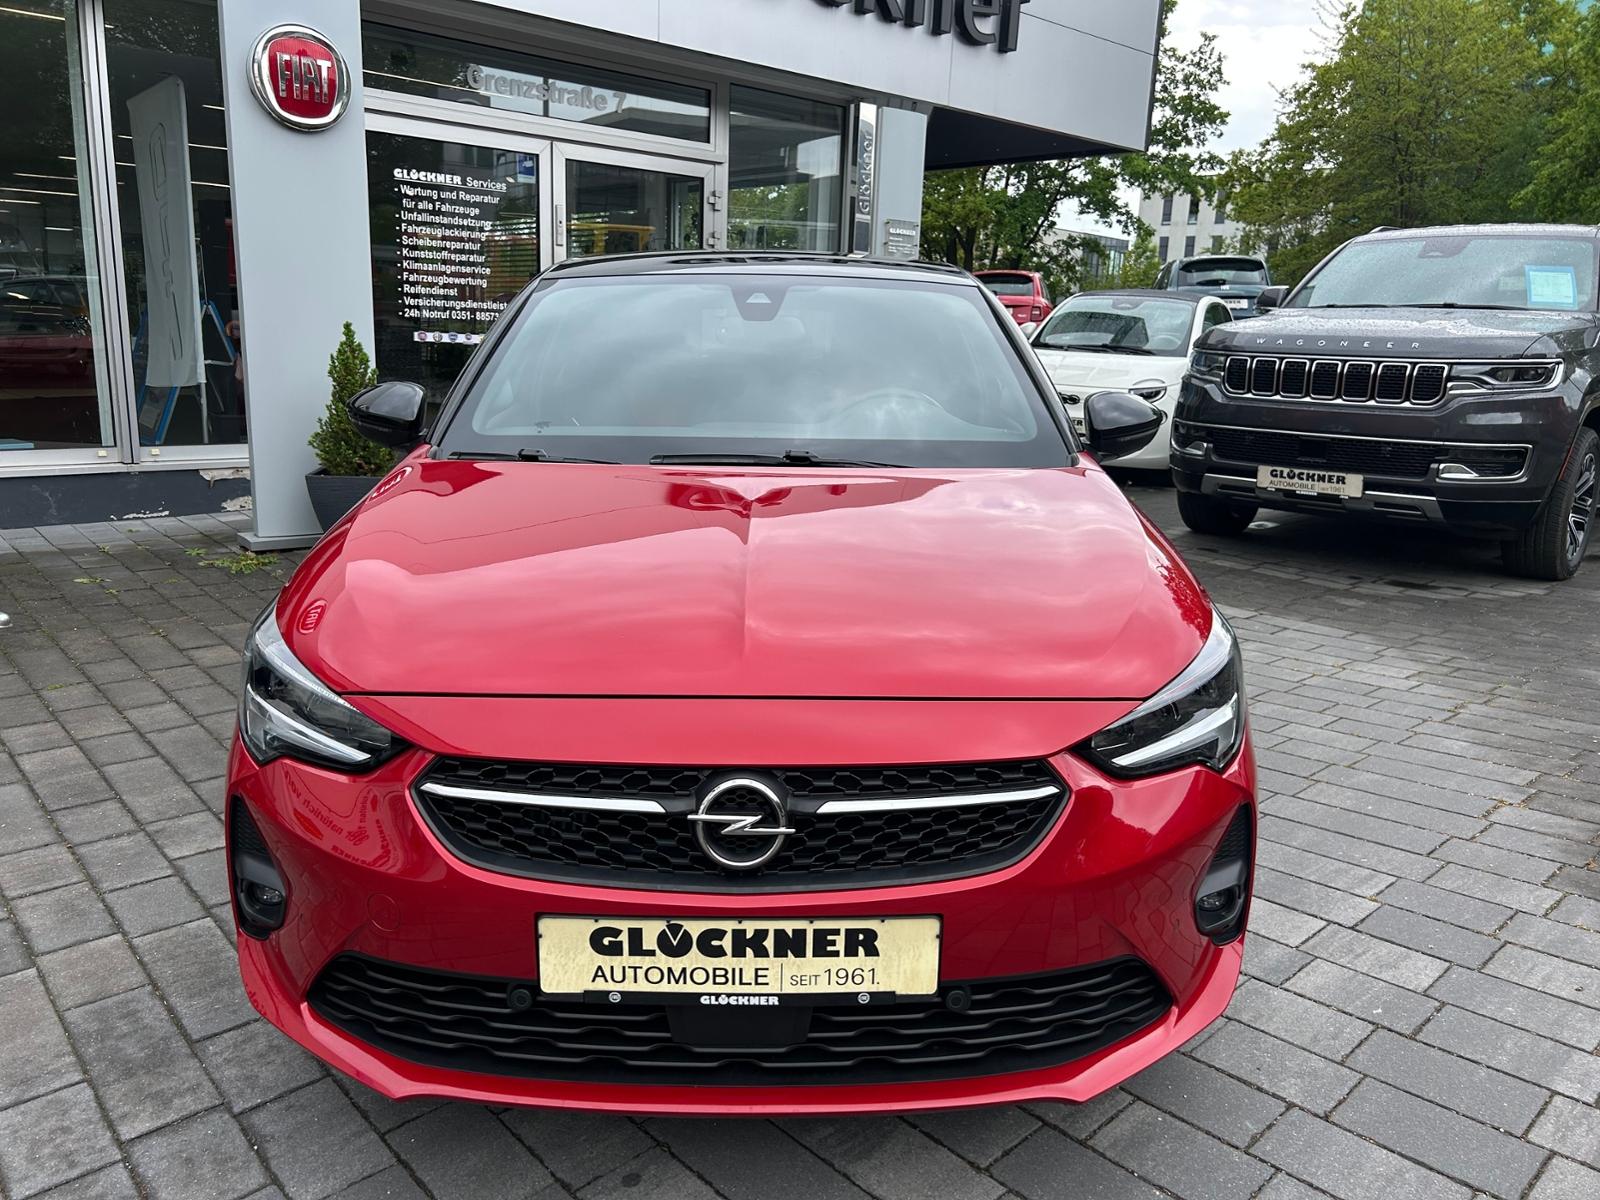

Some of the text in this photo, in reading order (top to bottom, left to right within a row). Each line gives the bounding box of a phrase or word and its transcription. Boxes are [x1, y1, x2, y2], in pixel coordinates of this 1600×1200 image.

[276, 51, 332, 104] FIAT
[466, 63, 627, 114] Grenzstraße 7
[466, 177, 507, 191] Services
[400, 184, 500, 204] Wartung und Reparatur
[402, 199, 480, 216] für alle Fahrzeuge
[401, 211, 492, 231] Unfallinstandsetzung
[401, 224, 486, 242] Fahrzeuglackierung
[401, 236, 481, 251] Scheibenreparatur
[402, 248, 486, 263] Kunststoffreparatur
[402, 260, 491, 275] Klimaanlagenservice
[403, 272, 487, 288] Fahrzeugbewertung
[403, 284, 458, 296] Reifendienst
[404, 308, 420, 319] 24h
[422, 309, 450, 320] Notruf
[1256, 337, 1420, 349] WAGONEER
[1269, 480, 1315, 490] AUTOMOBILE
[591, 965, 770, 986] AUTOMOBILE
[789, 973, 821, 987] SEIT
